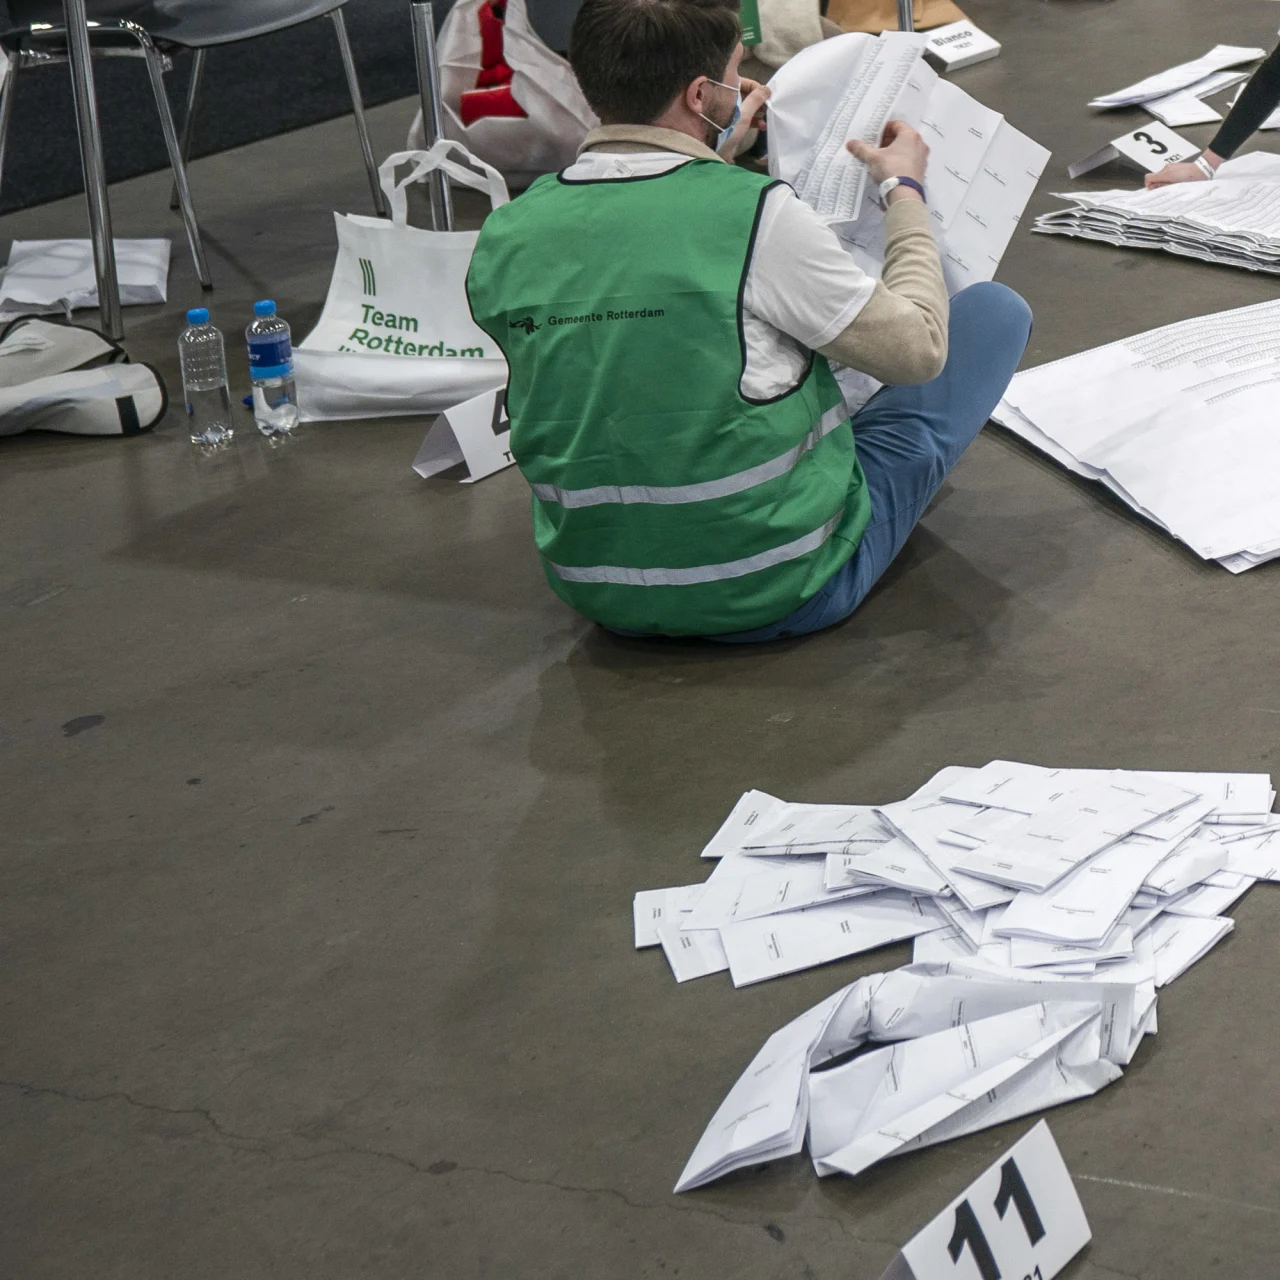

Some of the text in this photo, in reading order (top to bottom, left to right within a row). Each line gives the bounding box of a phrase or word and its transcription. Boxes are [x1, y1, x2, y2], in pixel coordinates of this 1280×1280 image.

[931, 29, 973, 47] Blanco
[1132, 131, 1169, 155] 3
[1163, 152, 1184, 164] TK21
[361, 303, 419, 334] Team
[547, 307, 665, 327] Gemeente Rotterdam
[947, 1156, 1046, 1280] 11
